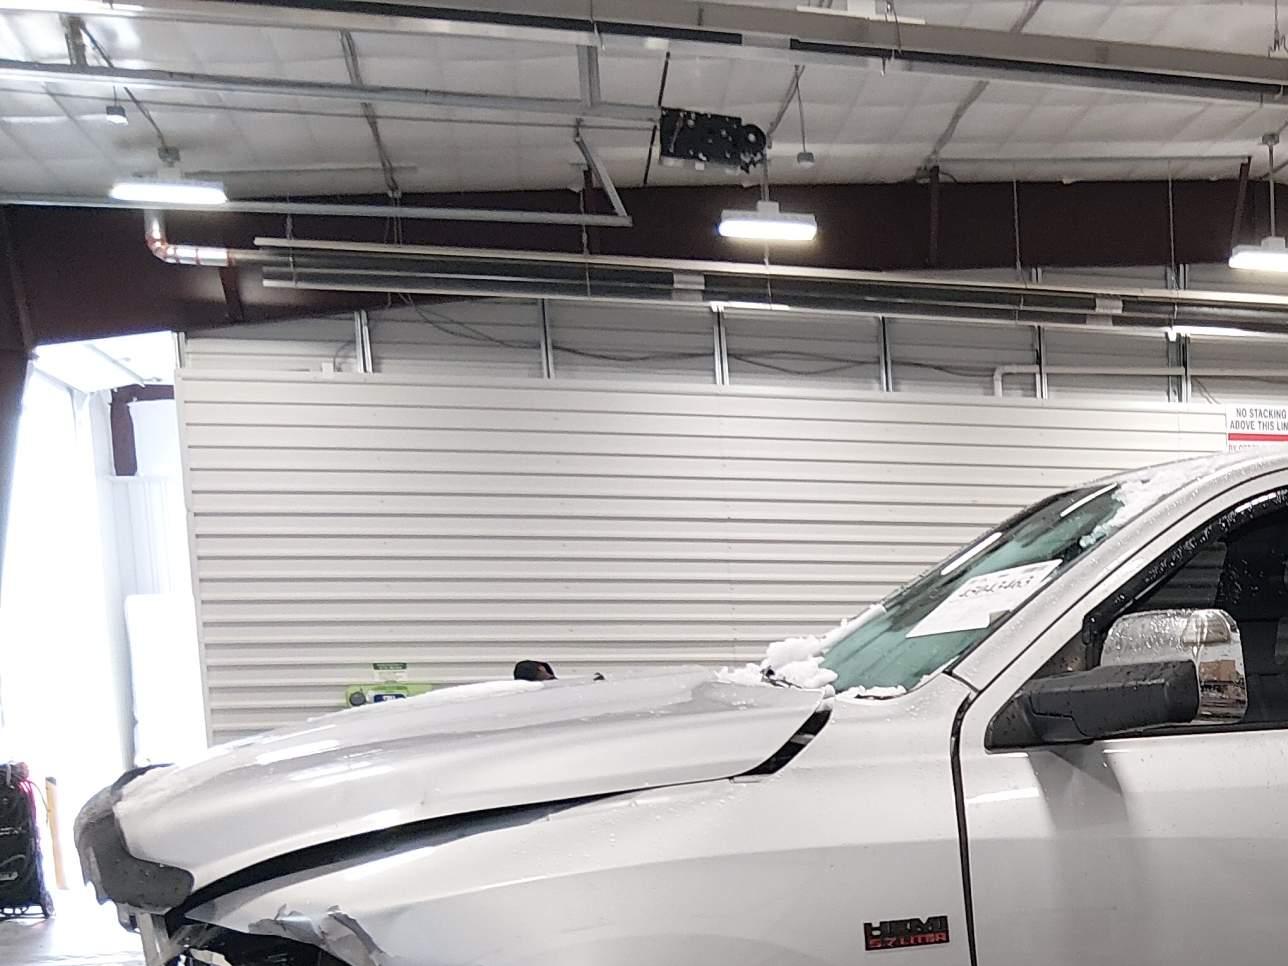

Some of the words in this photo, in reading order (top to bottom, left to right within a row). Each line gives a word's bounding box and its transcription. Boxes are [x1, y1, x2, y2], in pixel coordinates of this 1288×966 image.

[1236, 408, 1247, 418] NO
[1249, 408, 1287, 419] STACKING
[1230, 420, 1255, 431] ABOVE
[1258, 421, 1275, 431] THIS
[863, 915, 947, 937] HEMI
